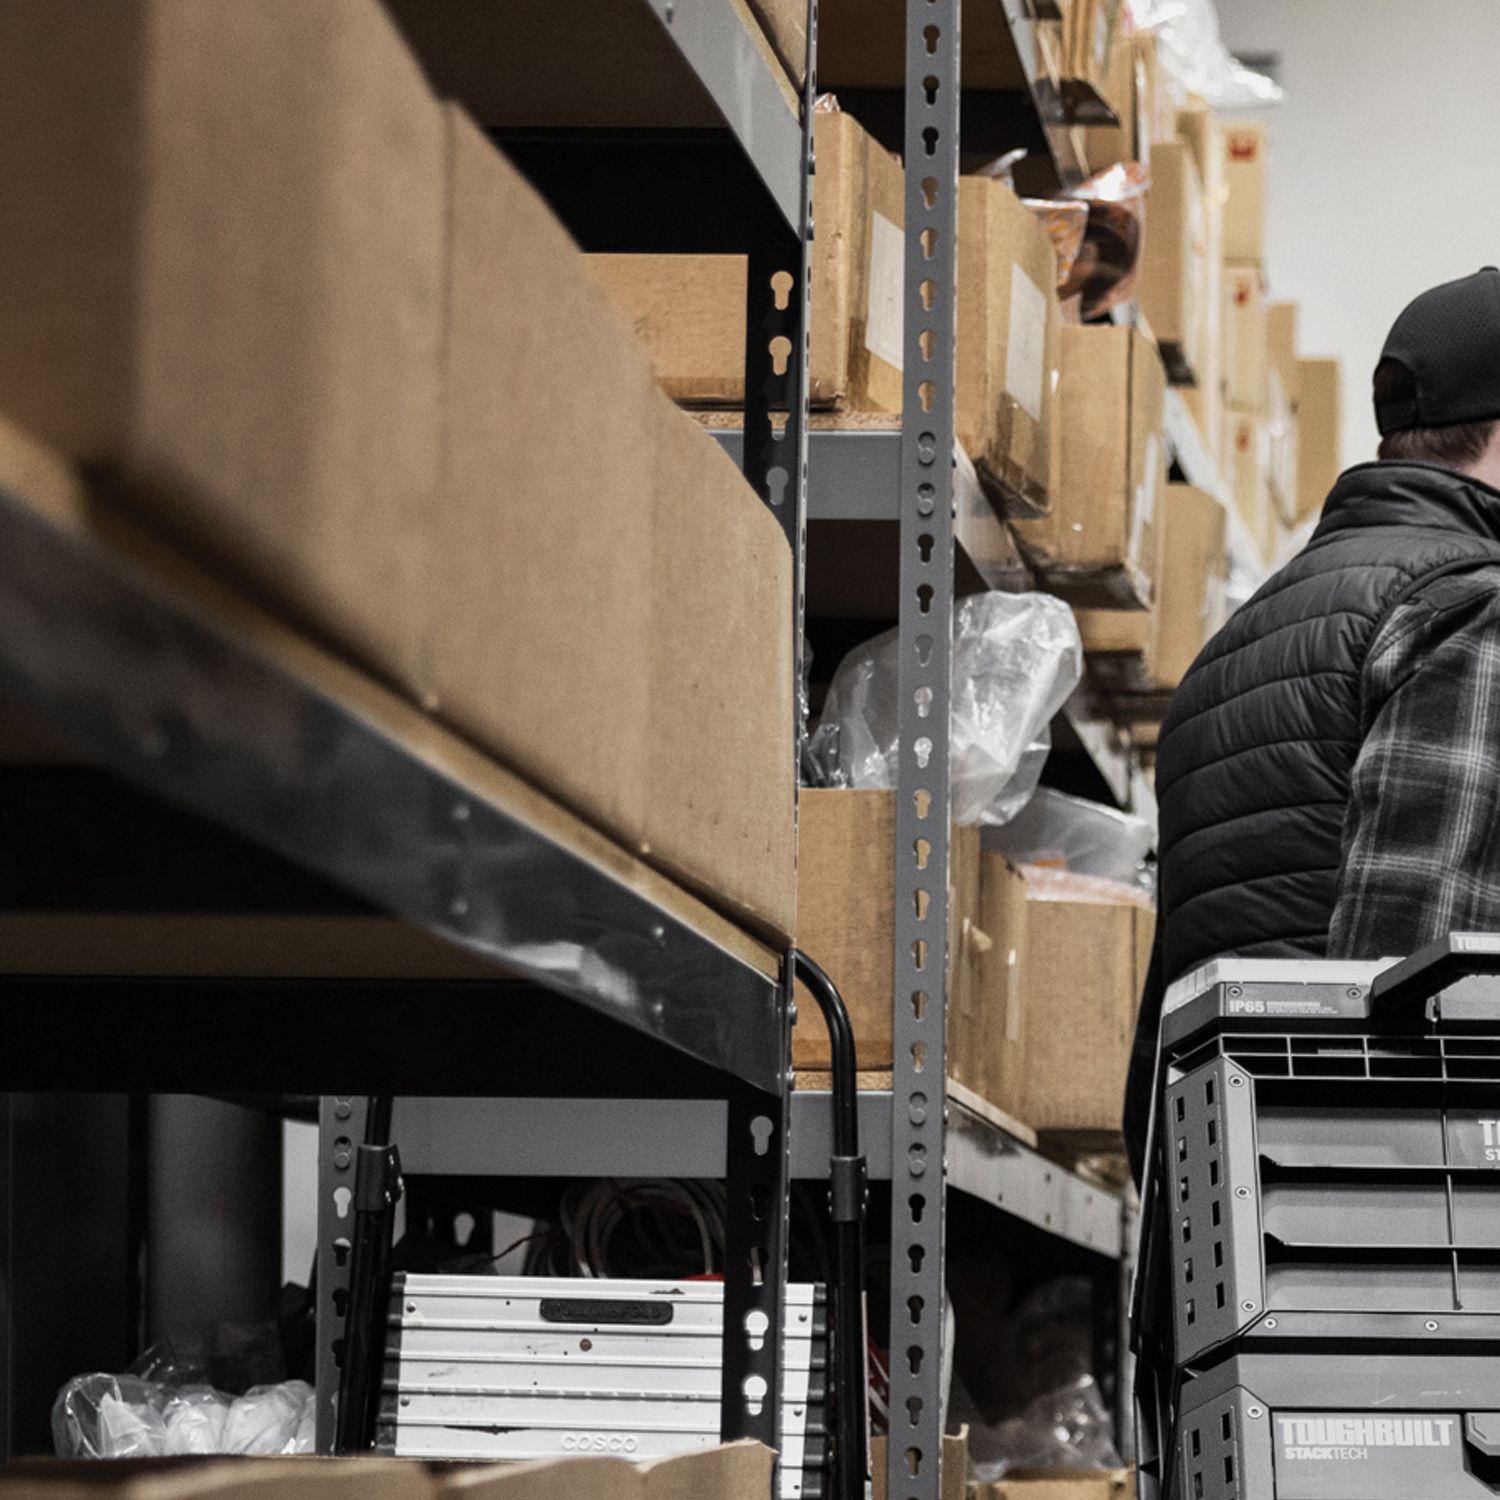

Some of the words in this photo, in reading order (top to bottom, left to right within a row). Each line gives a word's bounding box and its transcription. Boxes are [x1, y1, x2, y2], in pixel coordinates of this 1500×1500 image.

[1228, 1000, 1265, 1013] IP65
[1278, 1418, 1453, 1446] TOUGHBUILT
[562, 1435, 638, 1453] COSCO
[1285, 1447, 1368, 1460] STACKTECH
